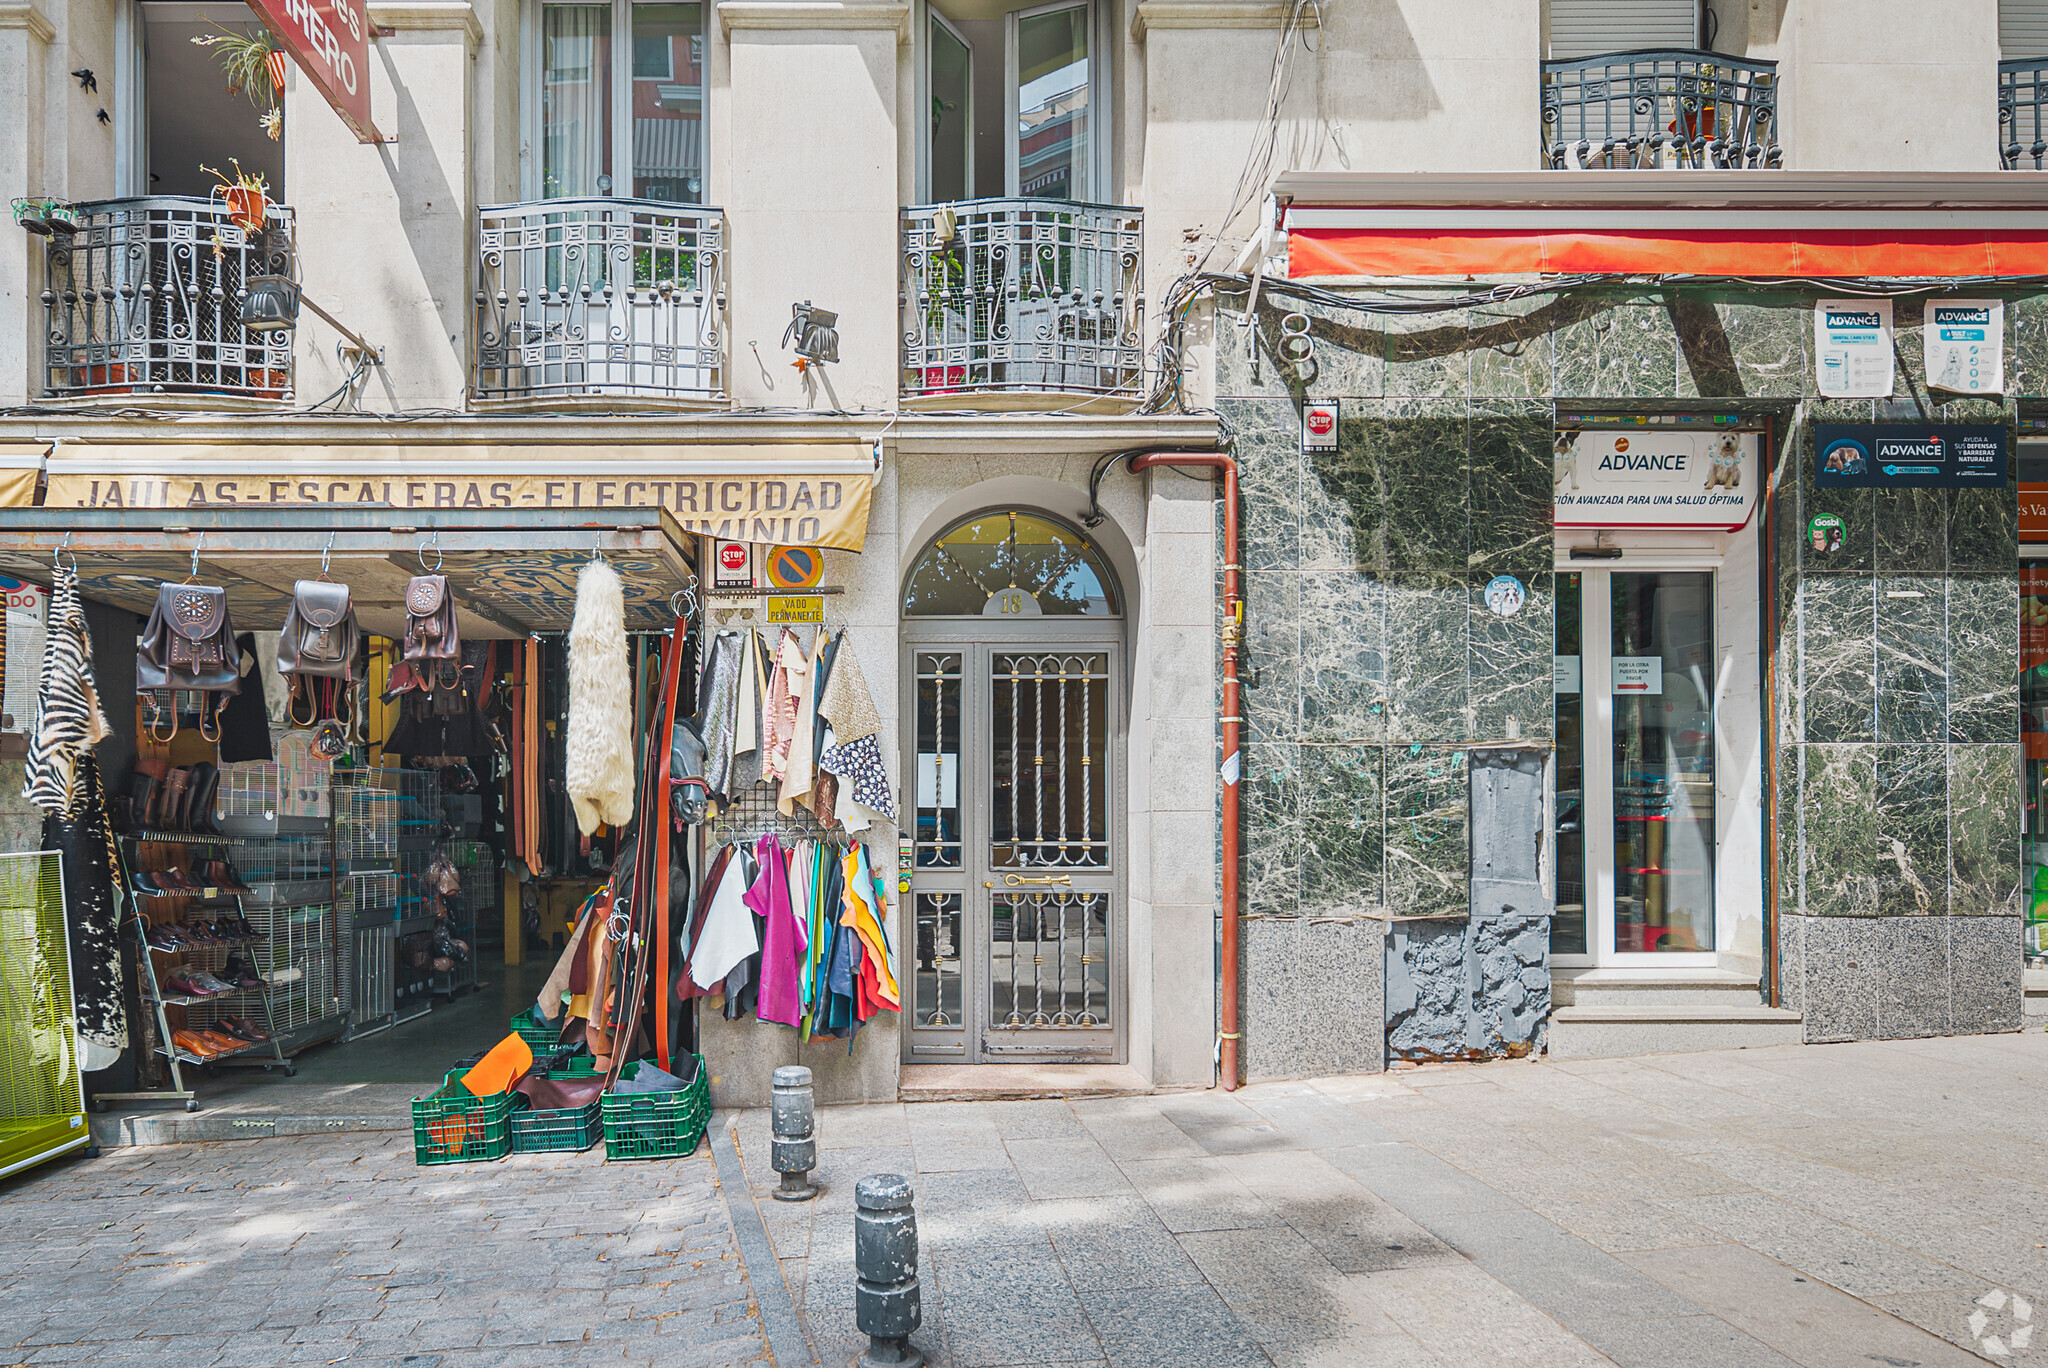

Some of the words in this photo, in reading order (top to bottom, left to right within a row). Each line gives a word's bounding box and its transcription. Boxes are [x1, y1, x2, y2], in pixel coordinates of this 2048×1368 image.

[331, 0, 360, 42] es
[1828, 316, 1878, 326] ADVANCE
[1938, 312, 1988, 322] ADVANCE
[1309, 416, 1331, 428] STOP
[1880, 445, 1942, 456] ADVANCE
[1598, 455, 1687, 471] ADVANCE
[1576, 496, 1623, 505] AVANZADA
[1626, 496, 1650, 505] PARA
[1652, 496, 1672, 505] UNA
[1675, 496, 1706, 505] SALUD
[1708, 493, 1744, 505] ÓPTIMA
[1814, 518, 1840, 527] Gosbi
[722, 550, 745, 562] STOP
[1492, 580, 1517, 589] Gosbi
[785, 599, 807, 608] VADO
[1001, 593, 1022, 614] 18
[771, 611, 820, 621] PERMANENTE
